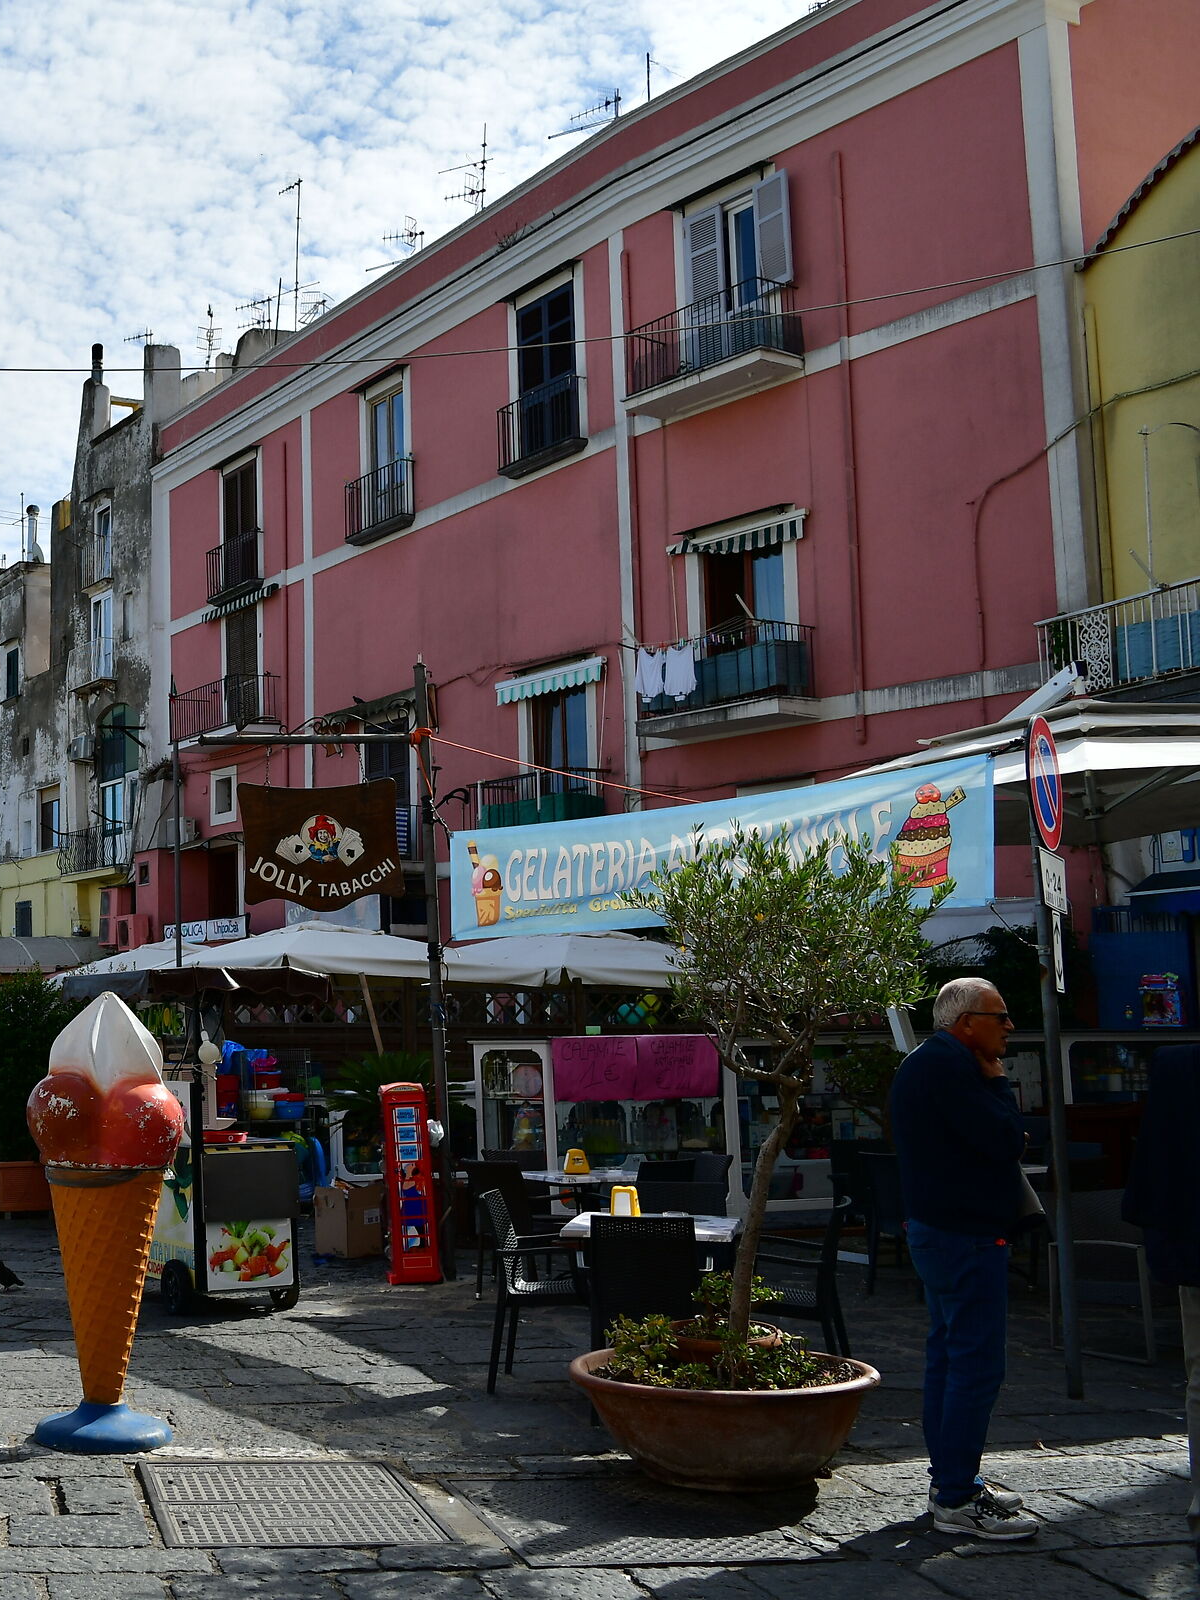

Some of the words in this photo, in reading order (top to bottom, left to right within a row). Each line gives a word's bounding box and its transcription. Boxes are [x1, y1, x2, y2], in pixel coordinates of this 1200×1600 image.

[249, 856, 312, 896] JOLLY
[318, 858, 396, 897] TABACCHI
[505, 837, 657, 902] GELATERIA
[1045, 869, 1062, 894] 0-24
[165, 924, 203, 939] CAOLICA
[561, 1041, 625, 1061] CALAMITE
[651, 1039, 696, 1054] CALAMITE
[604, 1063, 620, 1081] €
